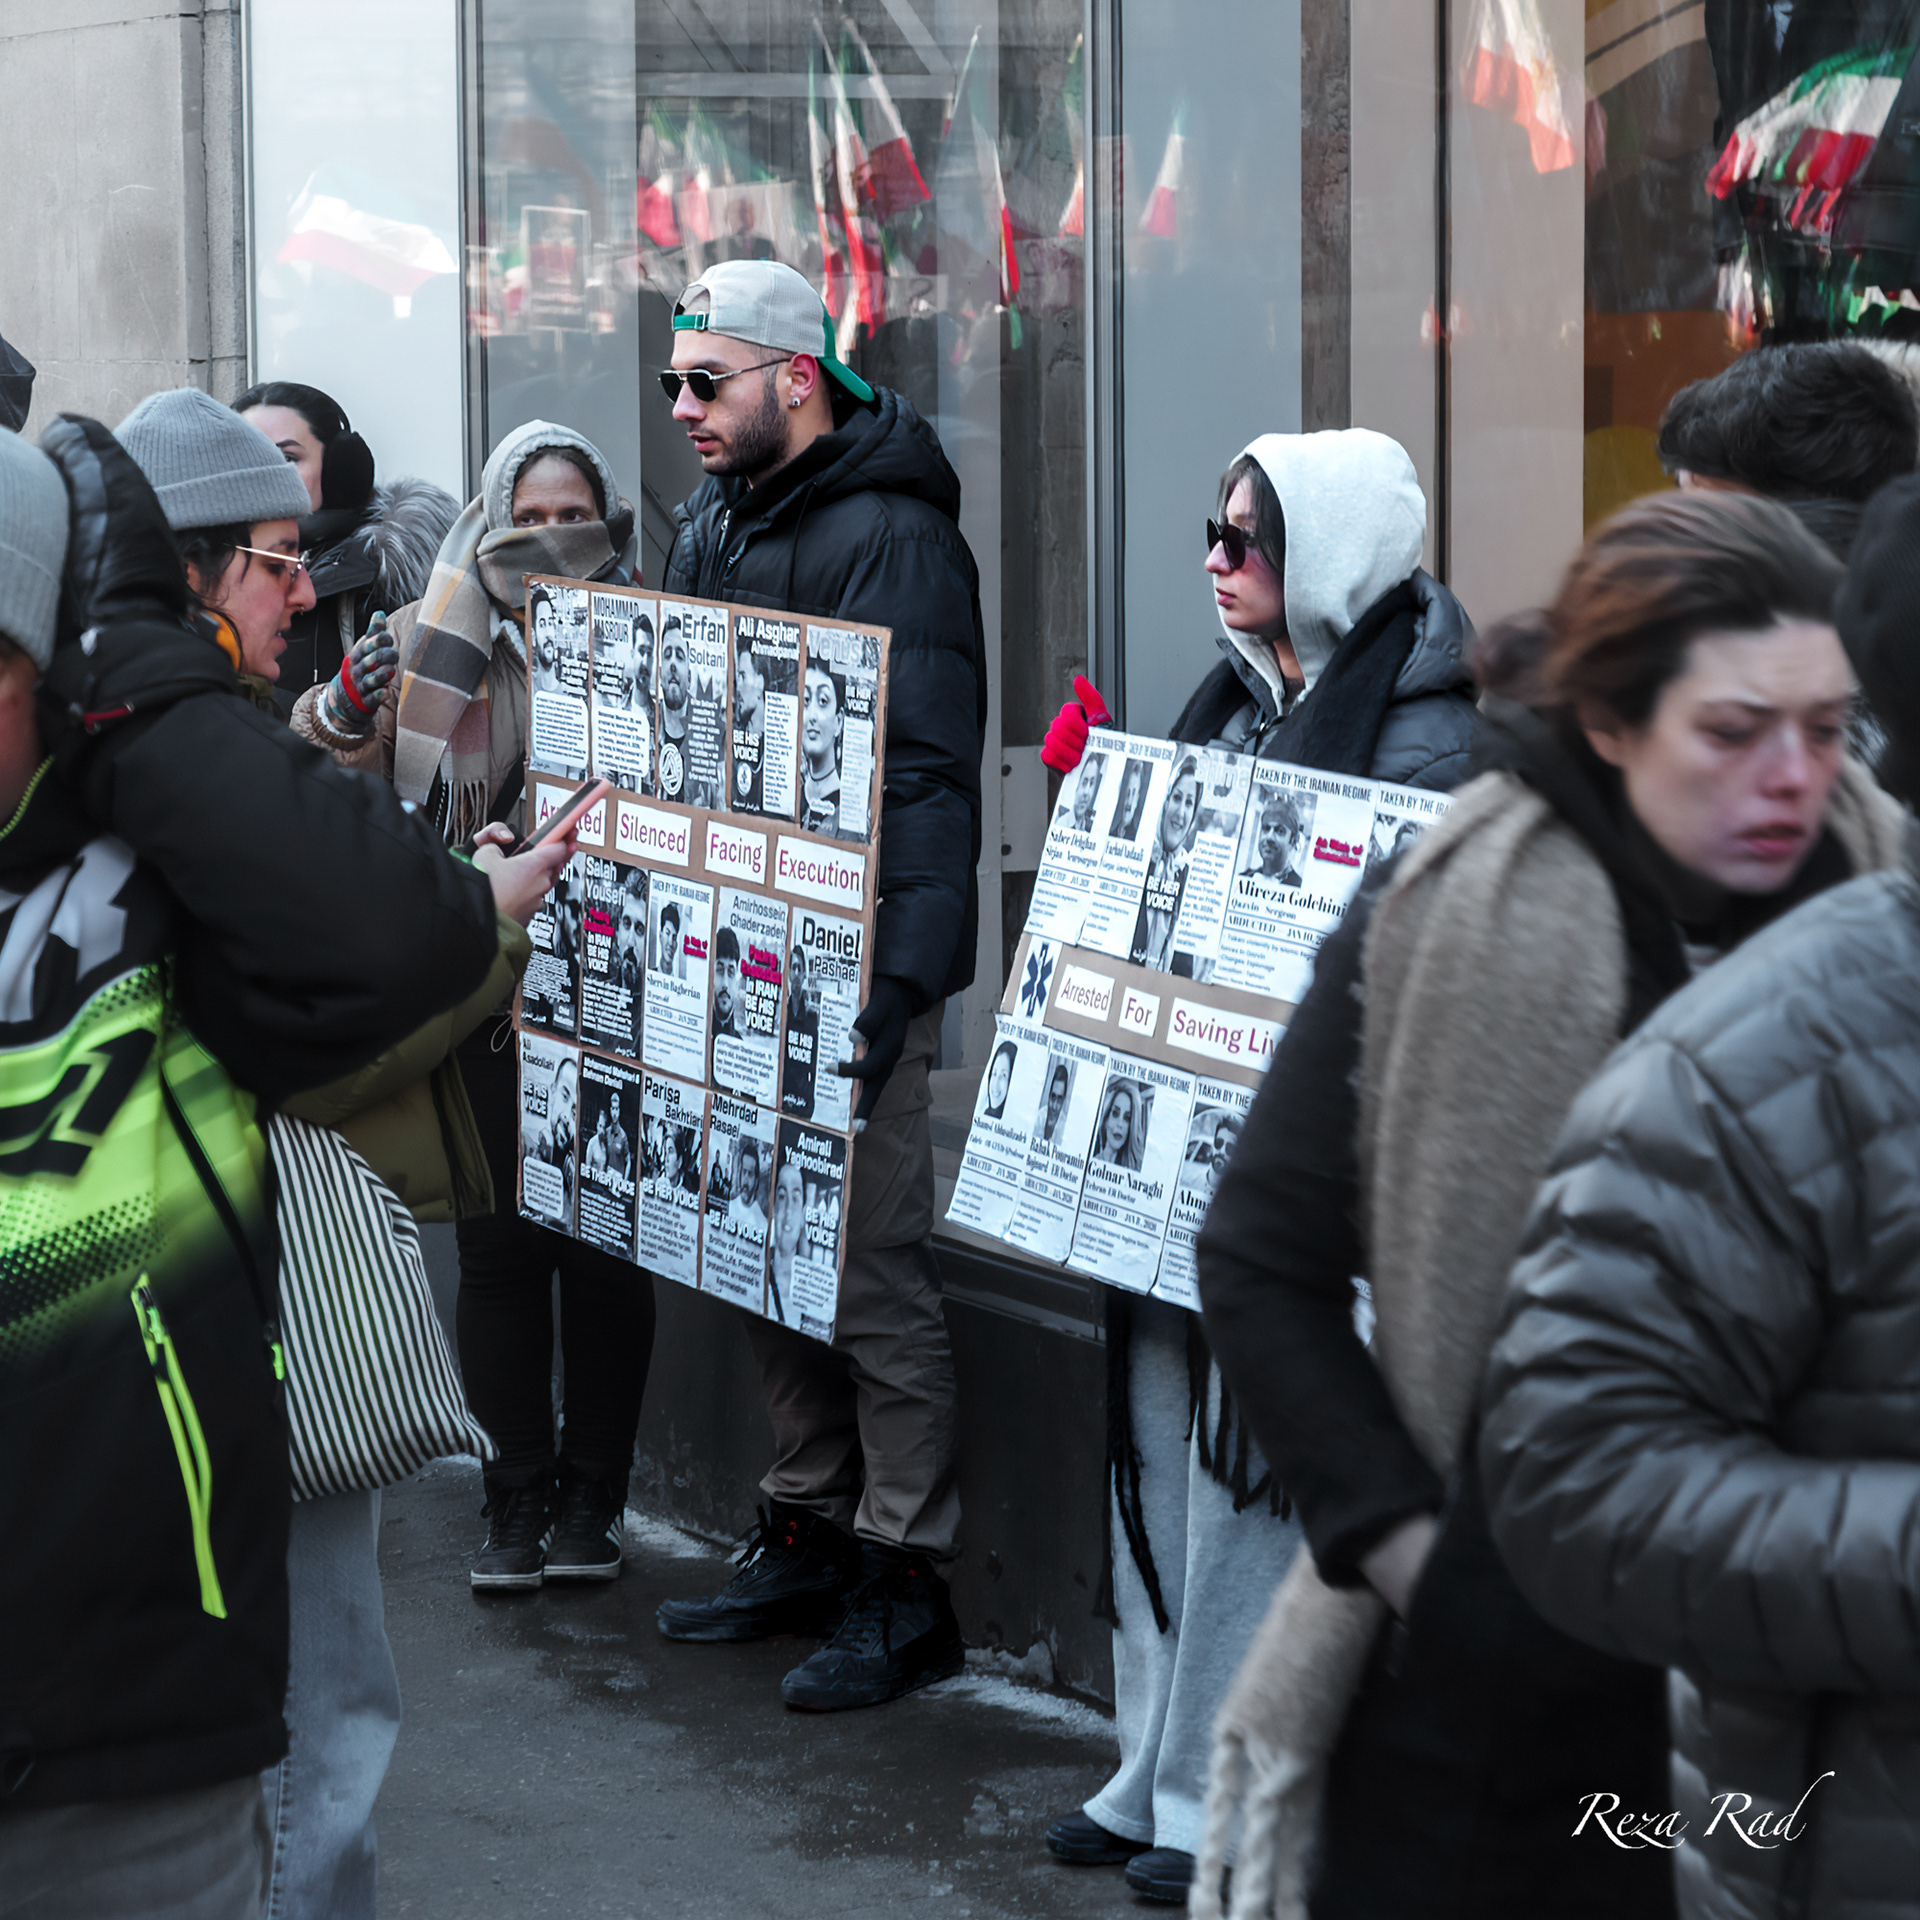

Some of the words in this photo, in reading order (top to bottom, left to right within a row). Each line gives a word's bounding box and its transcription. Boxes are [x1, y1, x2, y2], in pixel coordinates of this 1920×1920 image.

[682, 612, 727, 645] Erfan
[738, 617, 756, 638] Ali
[756, 620, 800, 647] Asghar
[689, 647, 727, 669] Soltani
[733, 729, 745, 744] BE
[733, 745, 760, 763] VOICE
[1255, 766, 1280, 784] TAKEN
[1280, 771, 1292, 786] BY
[1293, 773, 1308, 791] THE
[1309, 776, 1341, 797] IRANIAN
[1341, 784, 1373, 803] REGIME
[1379, 790, 1405, 808] TAKEN
[1406, 795, 1418, 810] BY
[1420, 798, 1434, 814] THE
[620, 813, 687, 856] Silenced
[710, 833, 763, 874] Facing
[779, 849, 860, 893] Execution
[586, 855, 617, 882] Salah
[585, 877, 628, 907] Yousefi
[1146, 874, 1160, 891] BE
[1160, 877, 1181, 897] HER
[1236, 879, 1287, 904] Alireza
[1288, 889, 1348, 919] Golchini
[732, 895, 787, 923] Amirhossein
[1145, 890, 1177, 913] VOICE
[730, 912, 787, 940] Ghaderzadeh
[1229, 914, 1276, 933] ABDUCTED
[802, 916, 861, 960] Daniel
[815, 955, 859, 983] Pashaei
[745, 975, 755, 993] In
[755, 978, 780, 1001] IRAN
[745, 992, 758, 1012] BE
[758, 996, 777, 1018] HIS
[1061, 977, 1109, 1012] Arrested
[1124, 996, 1153, 1028] For
[1173, 1009, 1246, 1056] Saving
[1248, 1027, 1277, 1059] Liv
[745, 1009, 775, 1035] VOICE
[788, 1030, 799, 1045] BE
[799, 1032, 813, 1049] HIS
[788, 1045, 812, 1065] VOICE
[644, 1075, 682, 1106] Parisa
[1198, 1082, 1222, 1101] TAKEN
[1222, 1088, 1235, 1104] BY
[1235, 1092, 1251, 1109] THE
[665, 1103, 705, 1129] Bakhtiari
[712, 1093, 759, 1126] Mehrdad
[797, 1131, 833, 1158] Amirali
[580, 1162, 591, 1179] BE
[785, 1145, 844, 1180] Yaghoobirad
[642, 1176, 655, 1195] BE
[655, 1180, 674, 1204] HER
[673, 1185, 701, 1211] VOICE
[1088, 1160, 1126, 1186] Golnar
[1125, 1171, 1165, 1201] Naraghi
[709, 1208, 722, 1229] BE
[722, 1212, 738, 1234] HIS
[737, 1219, 764, 1245] VOICE
[805, 1205, 820, 1225] BE
[819, 1211, 837, 1230] HIS
[805, 1223, 837, 1249] VOICE
[1169, 1229, 1197, 1247] ABDUC
